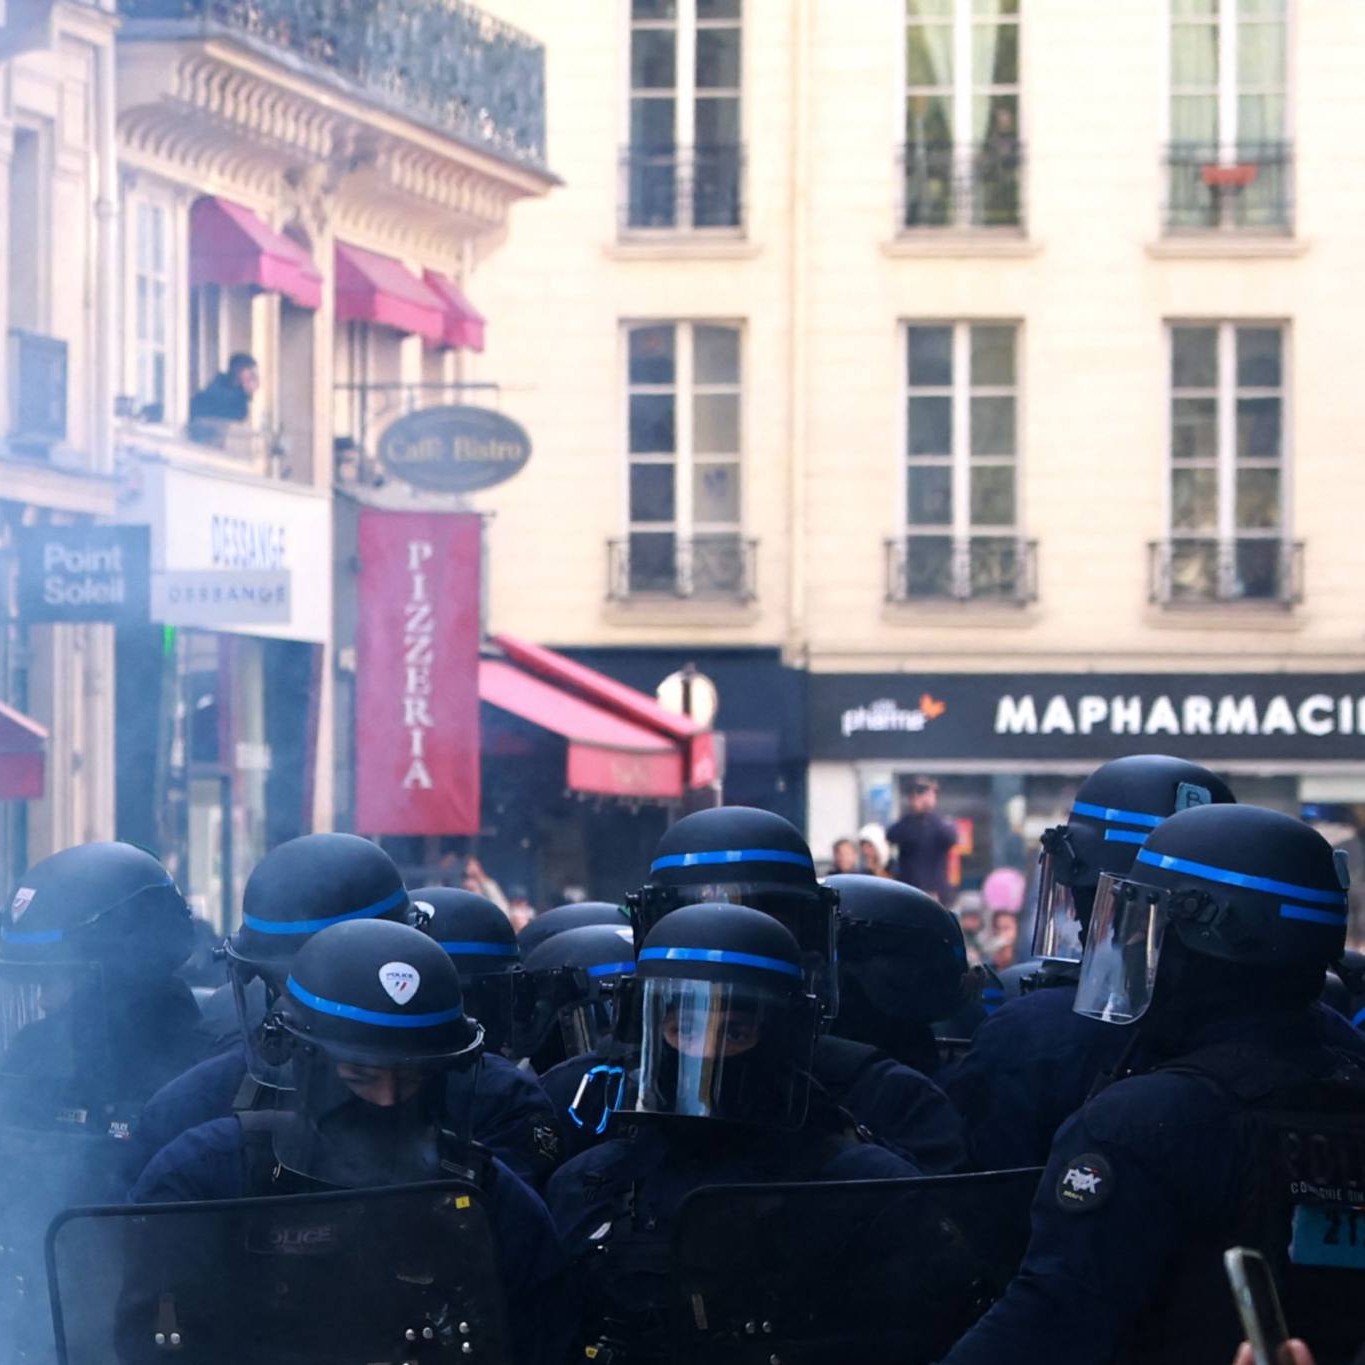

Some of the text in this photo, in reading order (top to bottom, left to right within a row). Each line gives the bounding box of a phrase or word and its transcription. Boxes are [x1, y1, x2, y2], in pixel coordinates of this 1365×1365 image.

[454, 434, 522, 462] Bistro
[44, 540, 123, 574] Point
[43, 573, 125, 606] Soleil
[168, 584, 287, 606] DESSANGE
[402, 541, 436, 791] PIZZERIA
